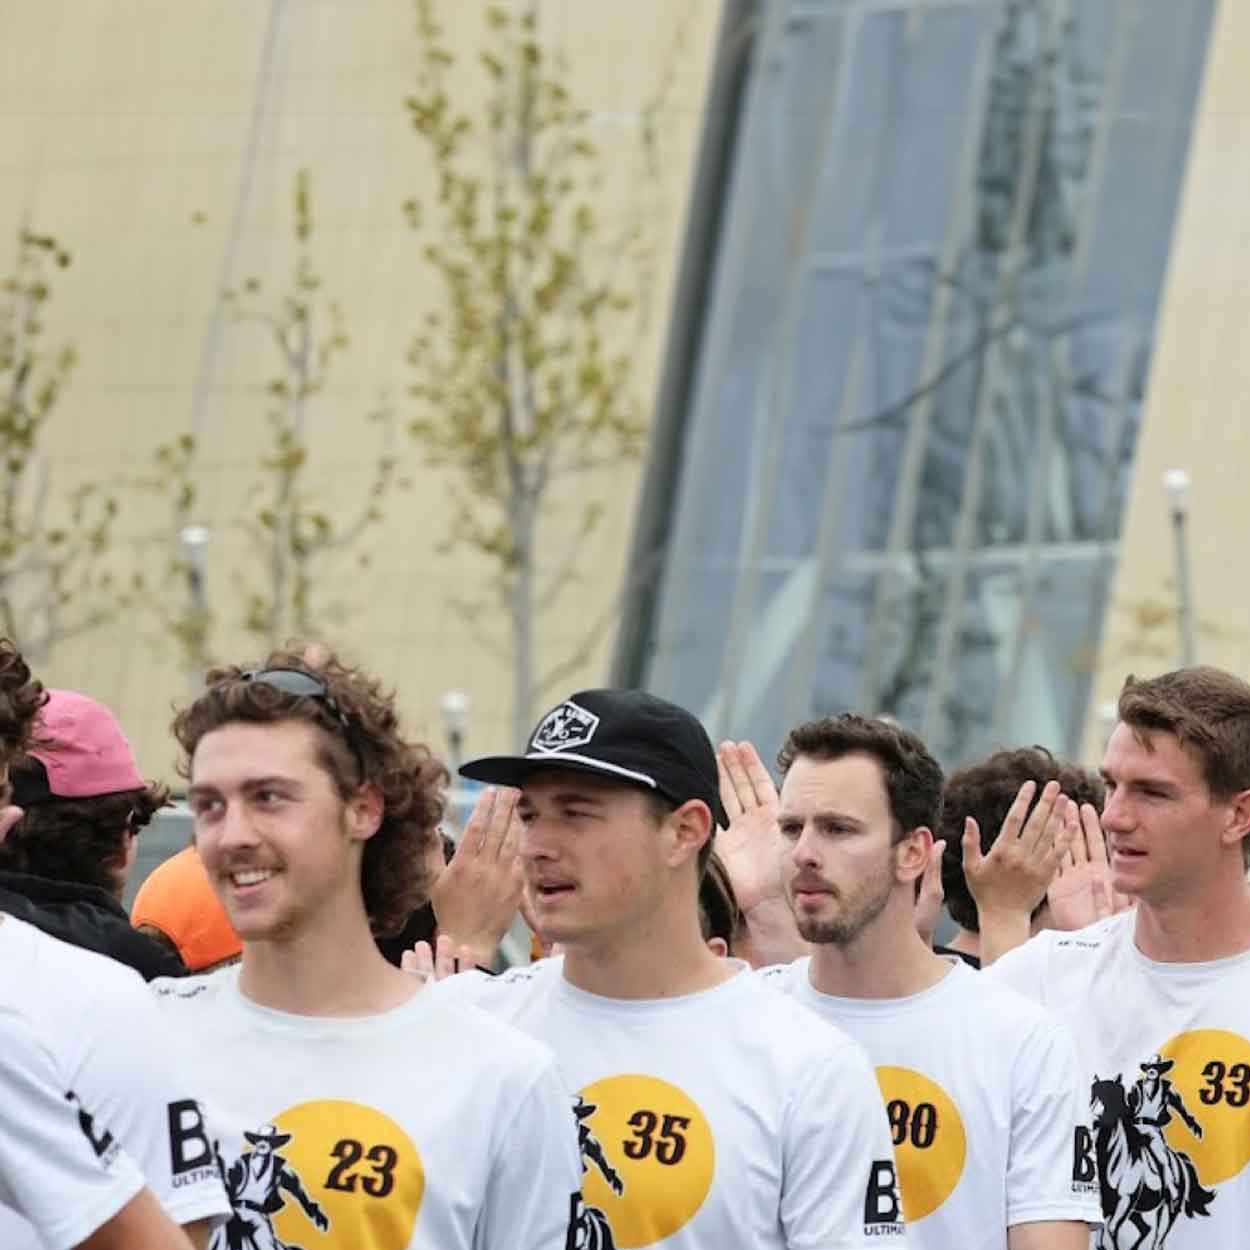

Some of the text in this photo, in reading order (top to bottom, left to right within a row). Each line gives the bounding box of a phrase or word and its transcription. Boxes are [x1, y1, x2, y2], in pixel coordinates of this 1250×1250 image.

[168, 1099, 212, 1175] B
[324, 1138, 398, 1198] 23
[623, 1110, 691, 1166] 35
[864, 1160, 900, 1225] B
